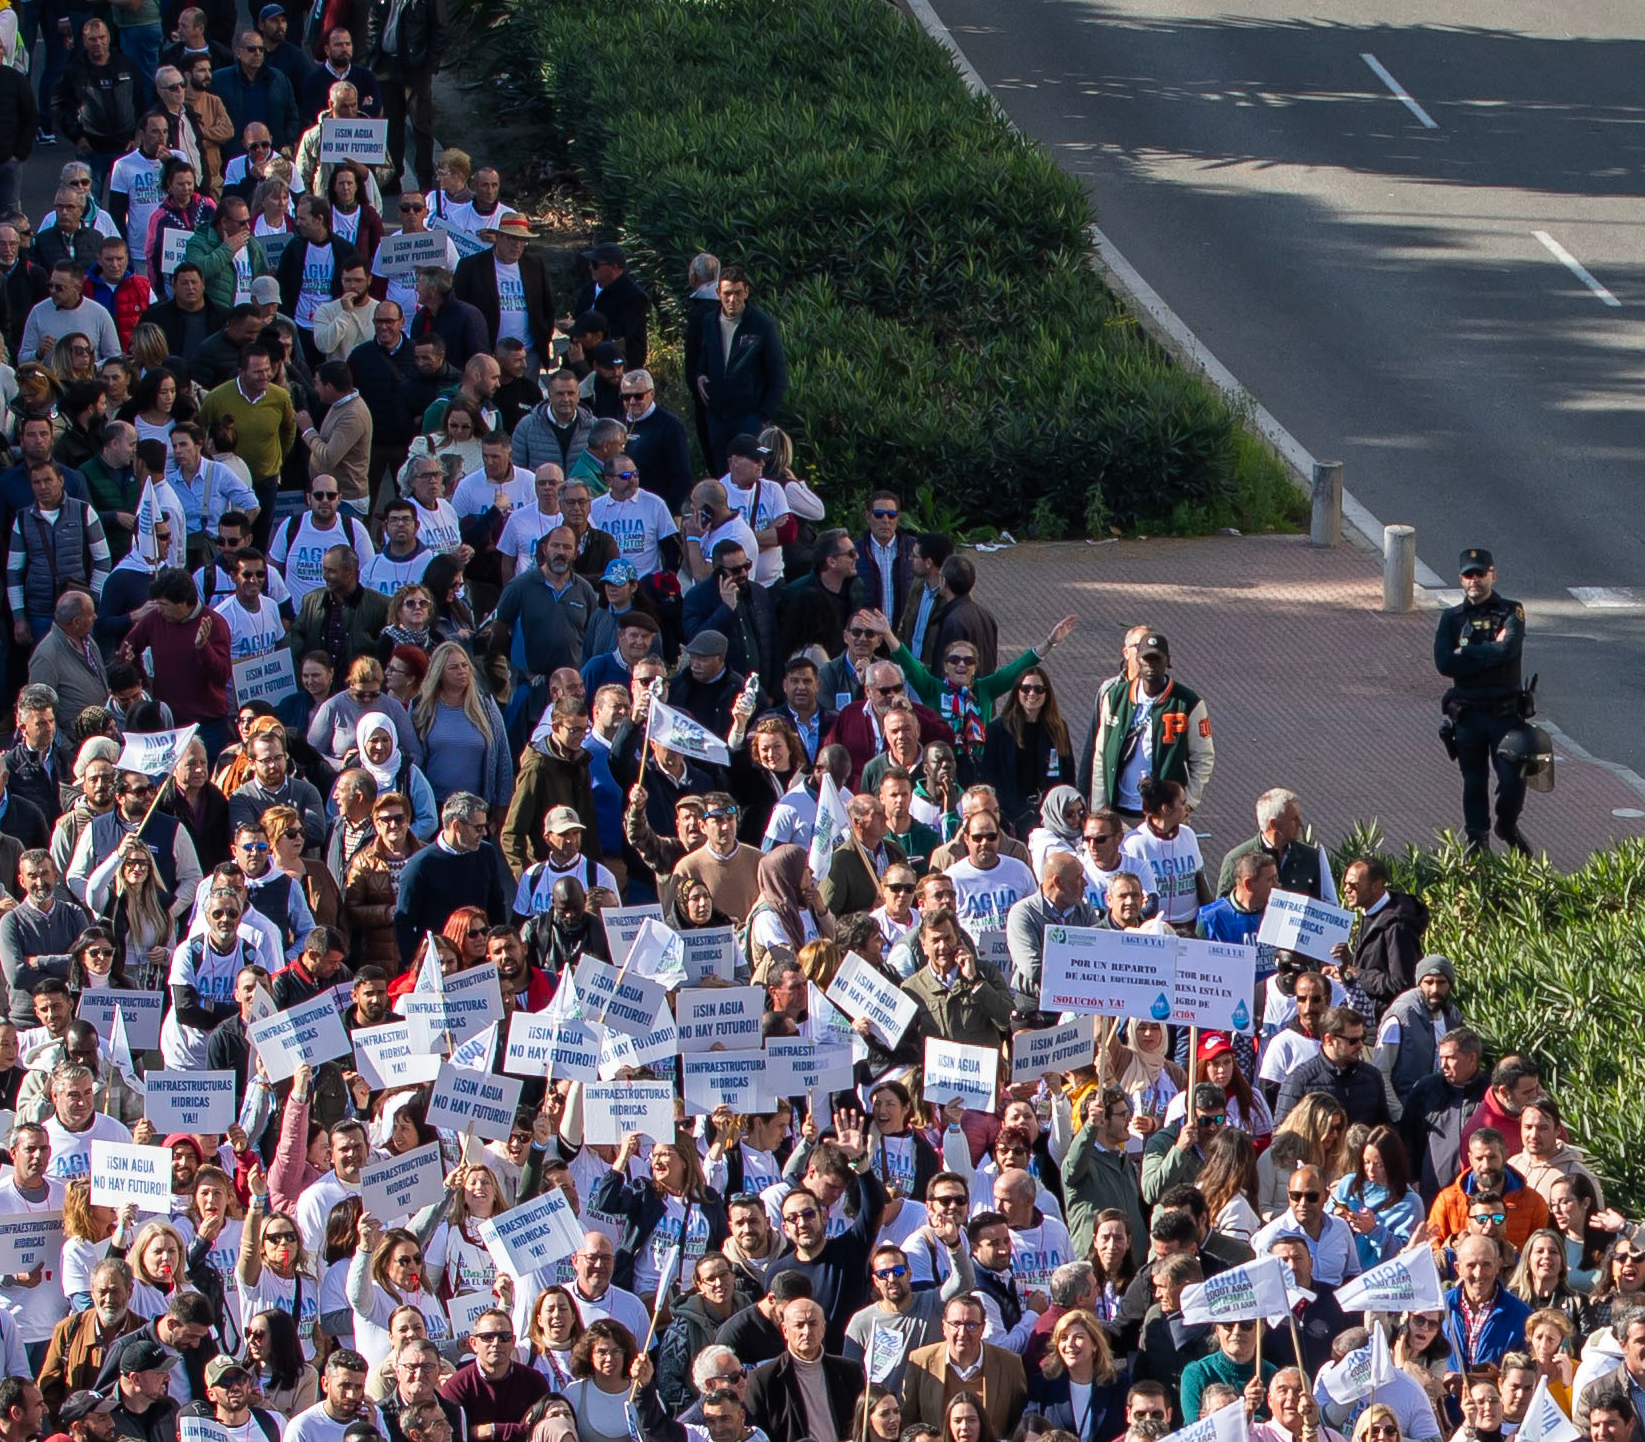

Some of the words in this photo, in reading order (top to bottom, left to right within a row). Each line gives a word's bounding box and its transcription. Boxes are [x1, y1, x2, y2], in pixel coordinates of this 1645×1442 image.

[1070, 958, 1091, 969] POR
[1094, 961, 1107, 970] UN
[1111, 963, 1157, 974] REPARTO
[1065, 971, 1078, 980] DE
[1080, 973, 1106, 983] AGUA
[1110, 976, 1169, 988] EQUILIBRADO.
[1200, 973, 1211, 982] DE
[1212, 974, 1223, 984] LA
[1199, 985, 1220, 997] ESTÁ
[1108, 998, 1125, 1008] YA!
[1198, 1000, 1210, 1009] DE
[171, 1097, 210, 1108] HIDRICAS
[182, 1112, 198, 1124] YA!!
